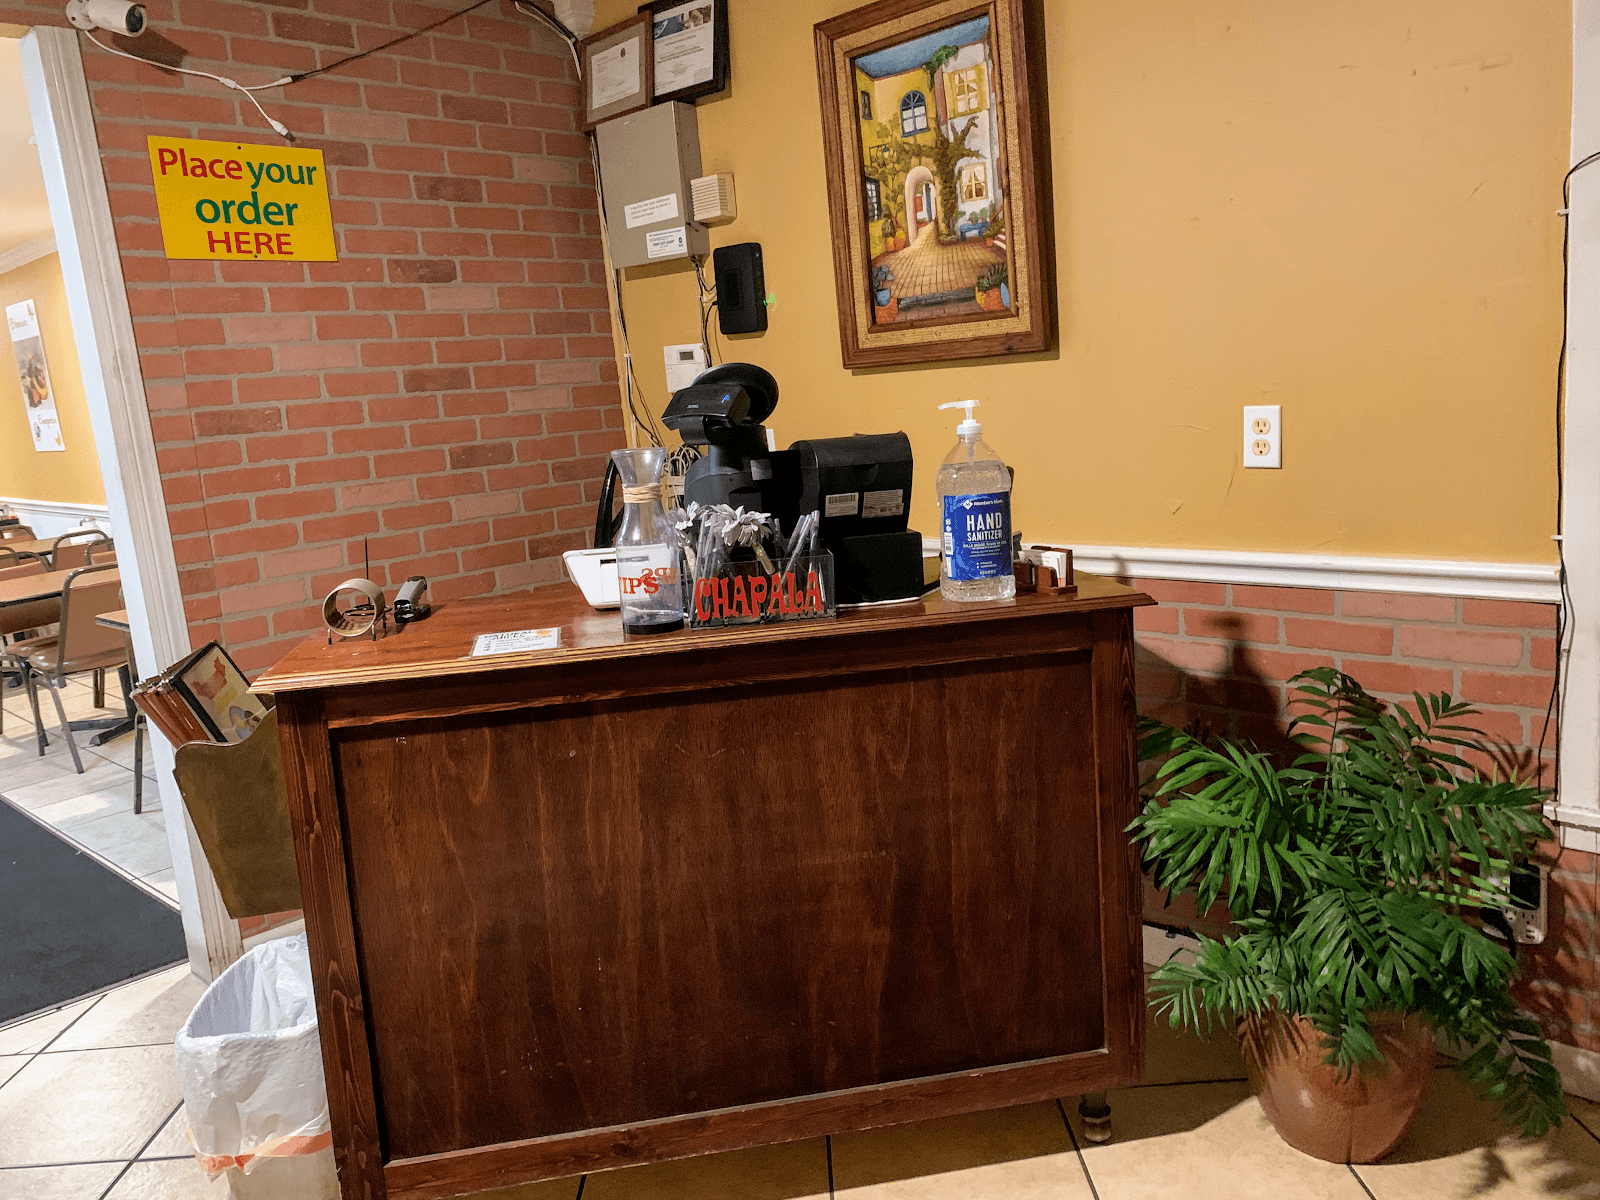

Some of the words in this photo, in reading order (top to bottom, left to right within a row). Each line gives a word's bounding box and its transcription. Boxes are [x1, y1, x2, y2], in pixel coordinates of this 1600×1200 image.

[158, 148, 243, 180] Place
[246, 161, 317, 190] your
[195, 191, 299, 226] order
[207, 230, 294, 255] HERE
[966, 513, 1003, 531] HAND
[967, 529, 1003, 542] SANITIZER
[694, 571, 824, 621] CHAPALA
